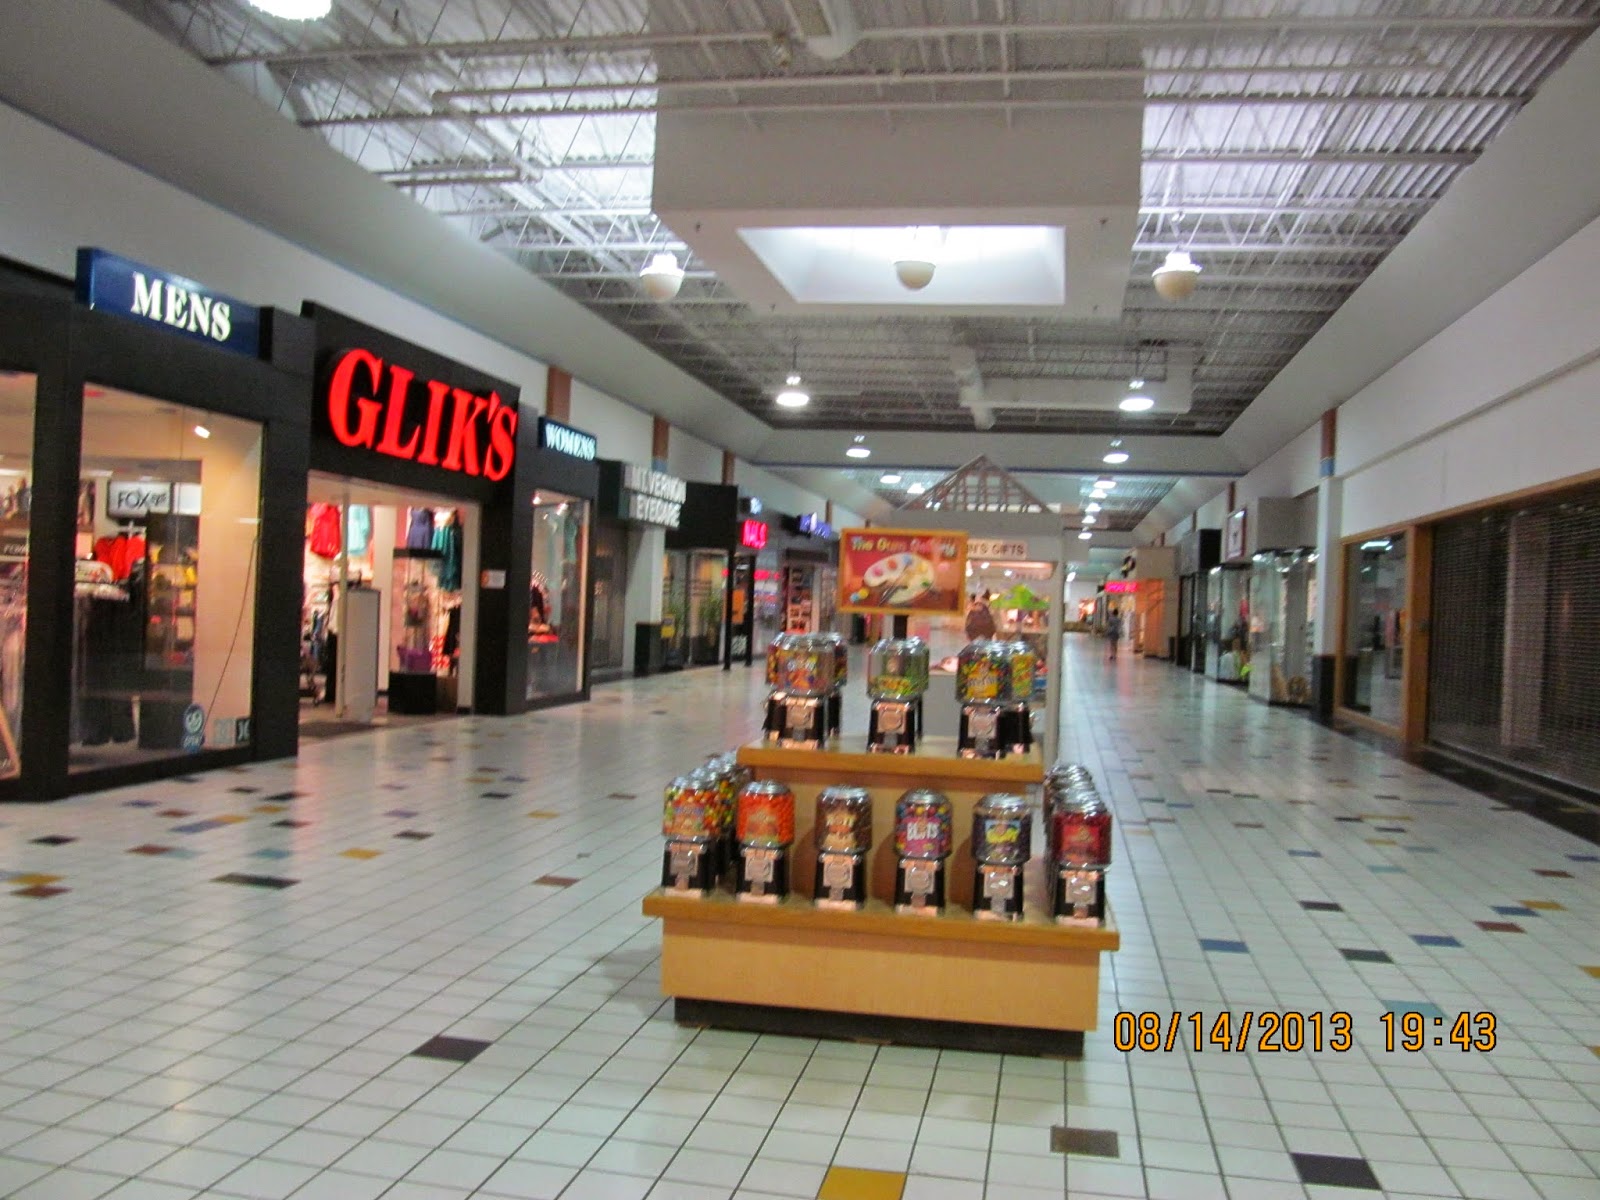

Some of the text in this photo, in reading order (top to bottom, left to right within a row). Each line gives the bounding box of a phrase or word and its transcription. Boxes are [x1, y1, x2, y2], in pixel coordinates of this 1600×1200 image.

[130, 270, 232, 342] MENS
[328, 348, 517, 482] GLIK'S
[545, 422, 596, 461] WOMENS
